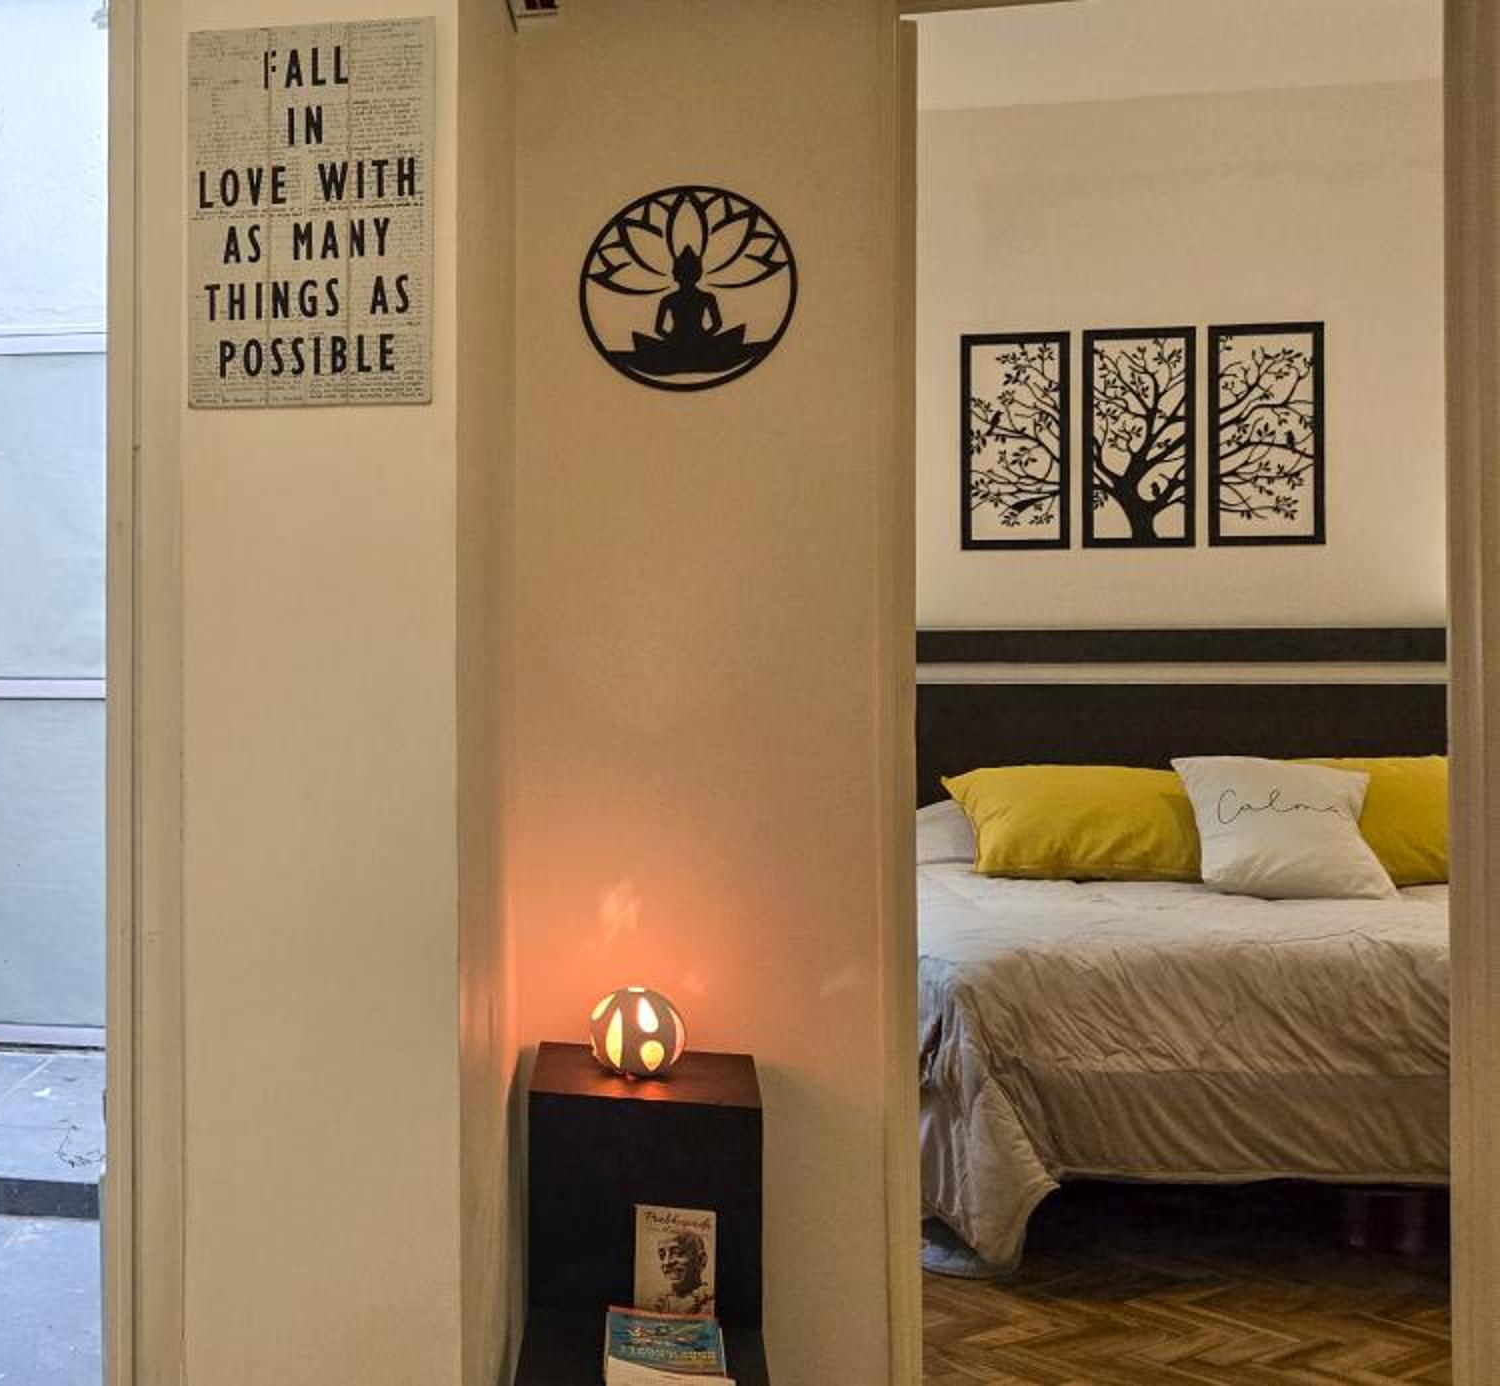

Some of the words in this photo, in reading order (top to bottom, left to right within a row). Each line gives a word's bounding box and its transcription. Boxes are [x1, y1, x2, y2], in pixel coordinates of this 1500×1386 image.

[263, 45, 349, 90] FALL
[287, 105, 323, 147] IN
[199, 165, 287, 209] LOVE
[317, 156, 416, 203] WITH
[223, 224, 261, 265] AS
[293, 217, 390, 261] MANY
[204, 277, 339, 322] THINGS
[369, 274, 409, 315] AS
[219, 333, 395, 379] POSSIBLE
